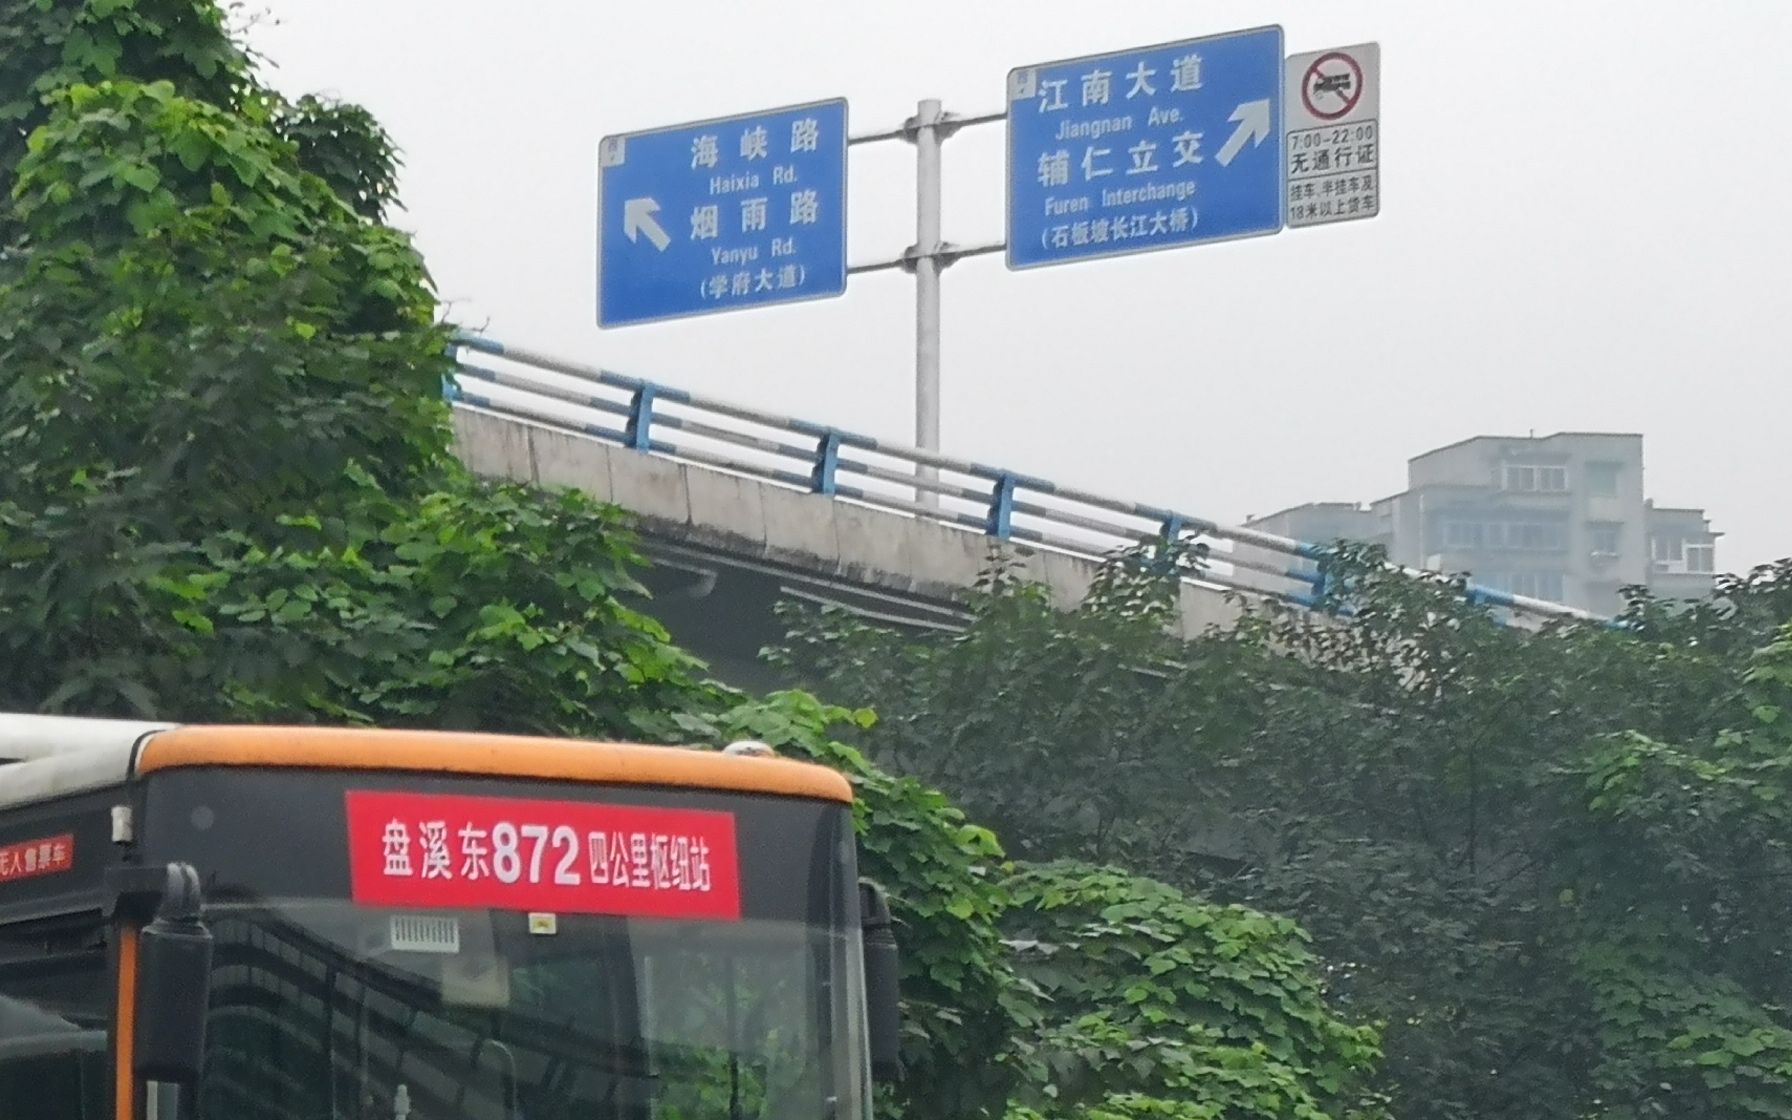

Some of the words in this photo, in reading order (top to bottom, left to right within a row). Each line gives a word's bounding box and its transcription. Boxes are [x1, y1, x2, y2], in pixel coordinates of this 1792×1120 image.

[1037, 53, 1204, 113] 江南大道
[1055, 114, 1133, 141] Jiangnan
[1148, 106, 1184, 126] Ave.
[690, 117, 820, 170] 海峡路
[1037, 130, 1205, 187] 辅仁立交
[1291, 143, 1374, 174] 无通行证
[709, 171, 760, 195] Haixia
[772, 166, 798, 185] Rd.
[1044, 194, 1088, 217] Furen
[1102, 180, 1196, 208] Interchange
[690, 189, 820, 241] 烟雨路
[1041, 206, 1199, 250] (石板坡长江大桥)
[711, 245, 758, 266] Yanyu
[771, 237, 797, 258] Rd.
[700, 264, 806, 299] (学府大道)
